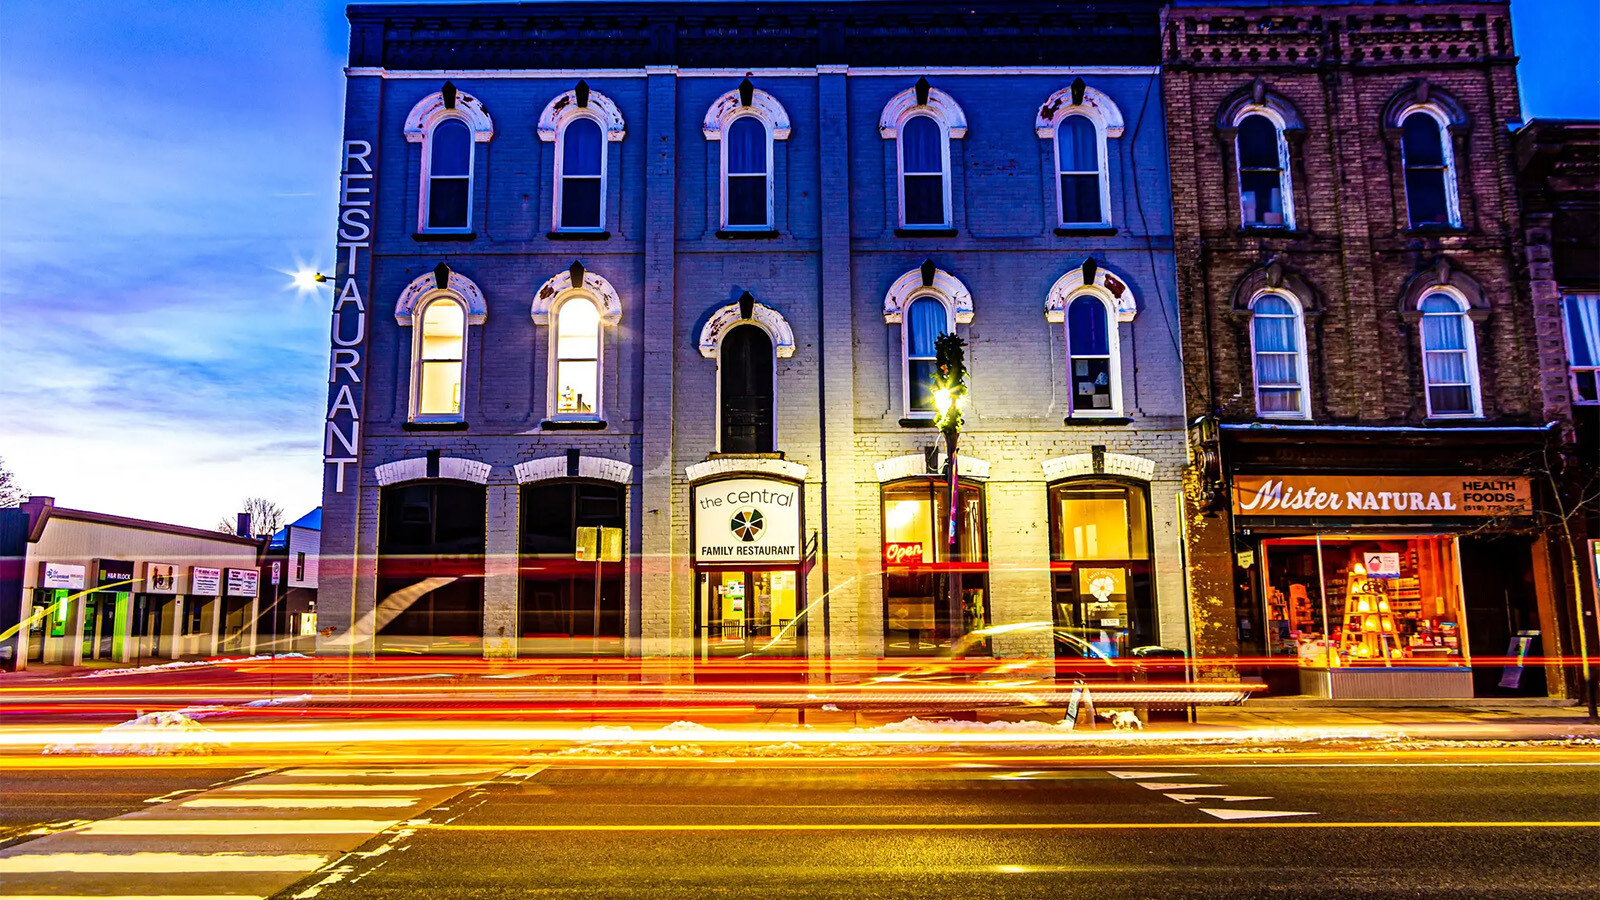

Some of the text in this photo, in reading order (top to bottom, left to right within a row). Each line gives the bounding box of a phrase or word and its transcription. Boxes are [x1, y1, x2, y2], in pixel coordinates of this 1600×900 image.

[325, 140, 373, 493] RESTAURANT
[1239, 480, 1457, 511] Mister NATURAL
[1463, 482, 1516, 490] HEALTH
[700, 488, 794, 510] the central
[1464, 493, 1516, 502] FOODS
[701, 545, 796, 556] FAMILY RESTAURANT
[886, 544, 922, 563] Open
